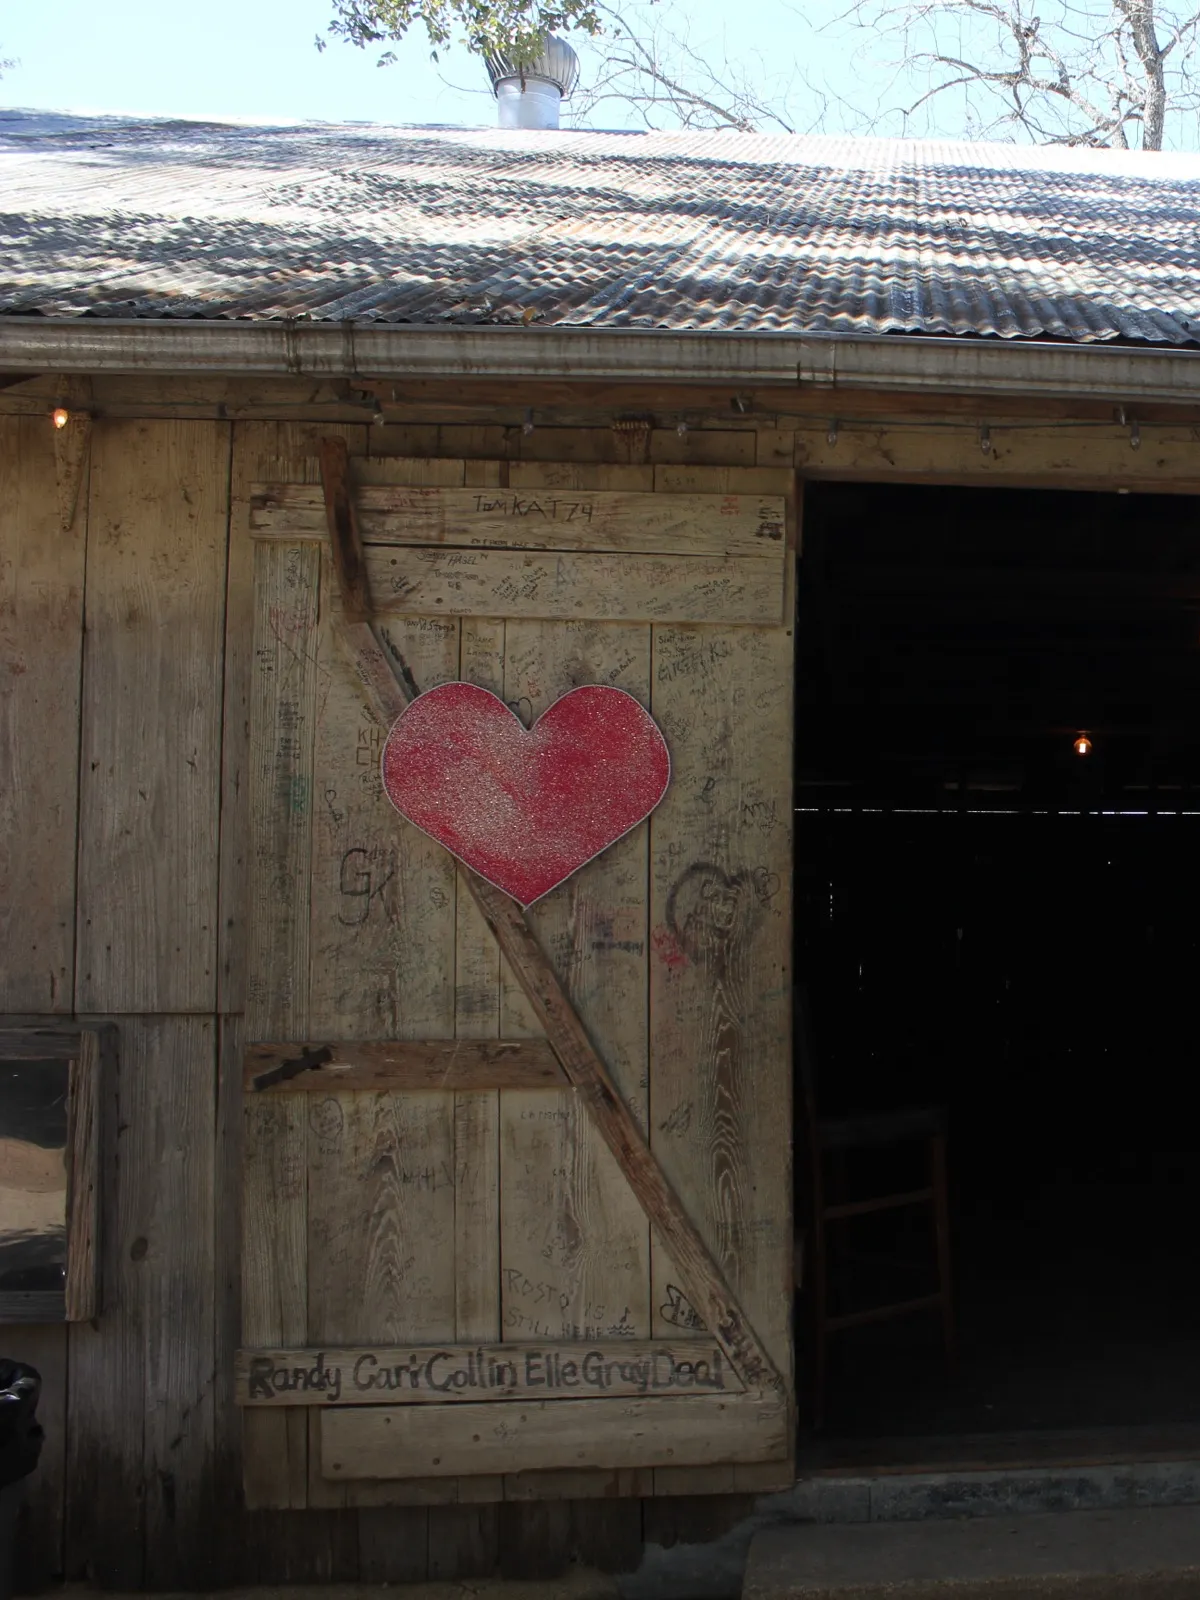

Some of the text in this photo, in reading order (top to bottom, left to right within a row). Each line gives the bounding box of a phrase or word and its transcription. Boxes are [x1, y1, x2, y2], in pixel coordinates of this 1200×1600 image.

[248, 1352, 342, 1402] Randy
[425, 1347, 518, 1395] Collin
[526, 1351, 580, 1389] Elle
